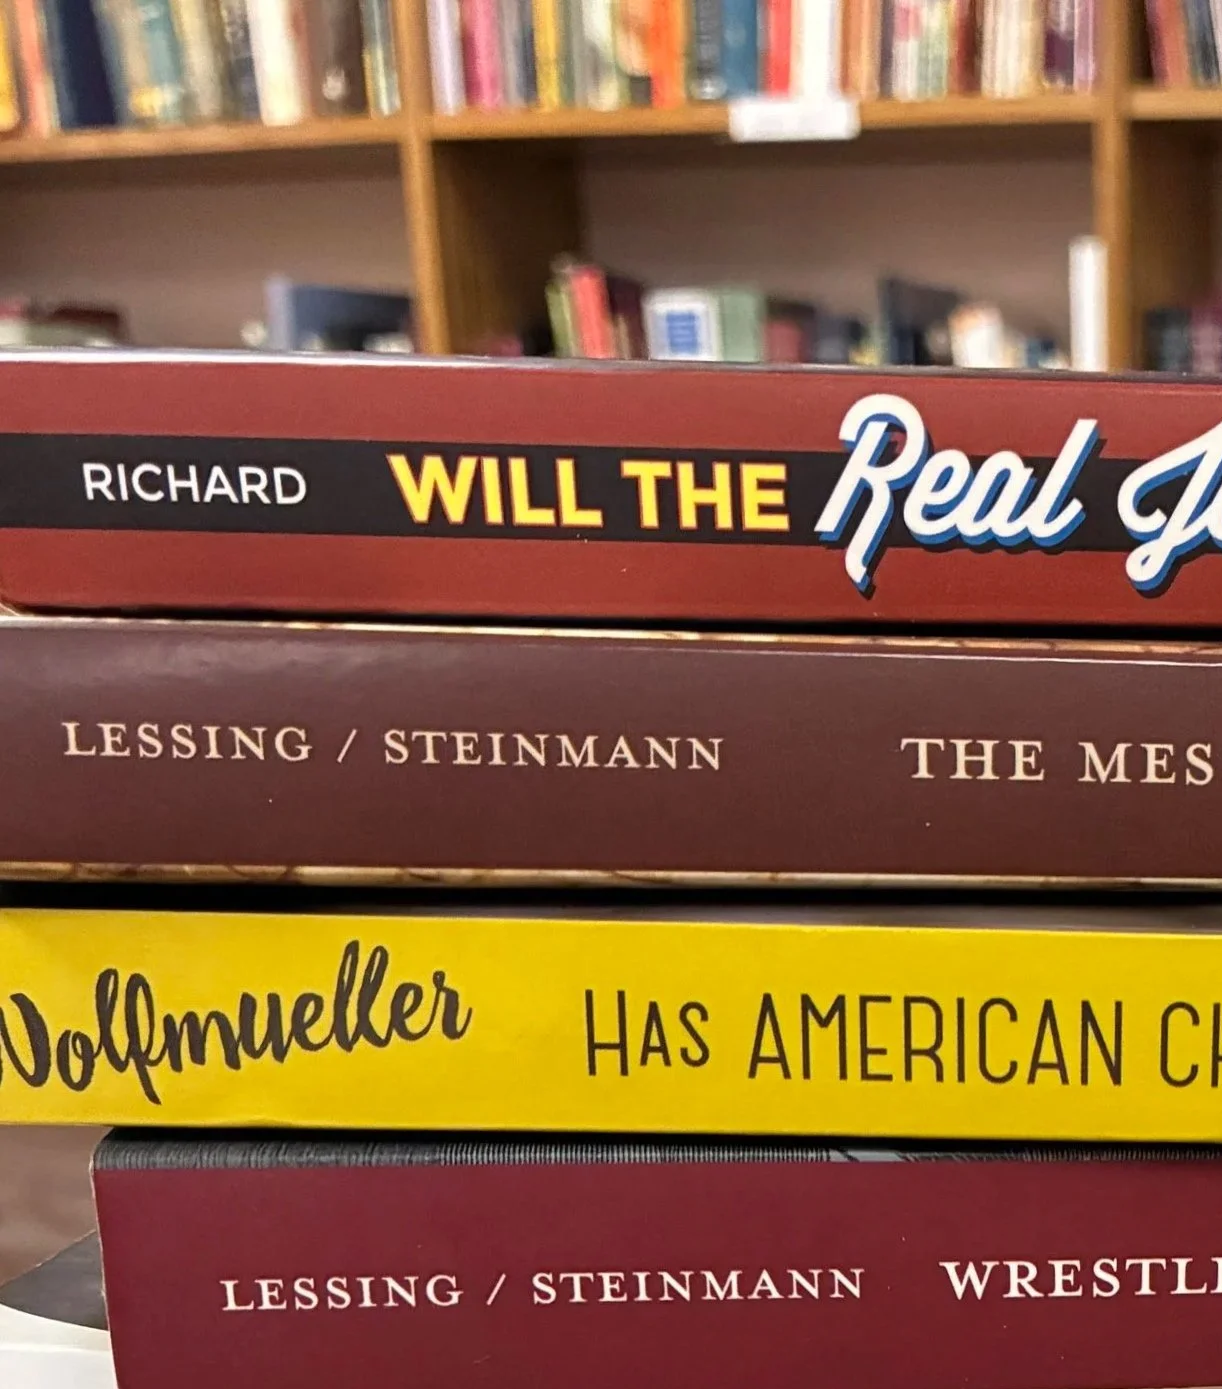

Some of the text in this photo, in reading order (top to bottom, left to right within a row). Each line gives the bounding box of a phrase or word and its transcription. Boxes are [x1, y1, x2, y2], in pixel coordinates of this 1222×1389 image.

[82, 462, 308, 506] RICHARD
[387, 452, 604, 528] WILL
[619, 460, 791, 532] THE
[814, 392, 1100, 600] Real
[62, 722, 724, 770] LESSING / STEINMANN
[900, 738, 1046, 782] THE
[748, 992, 1124, 1088] AMERICAN
[219, 1268, 866, 1314] LESSING / STEINMANN
